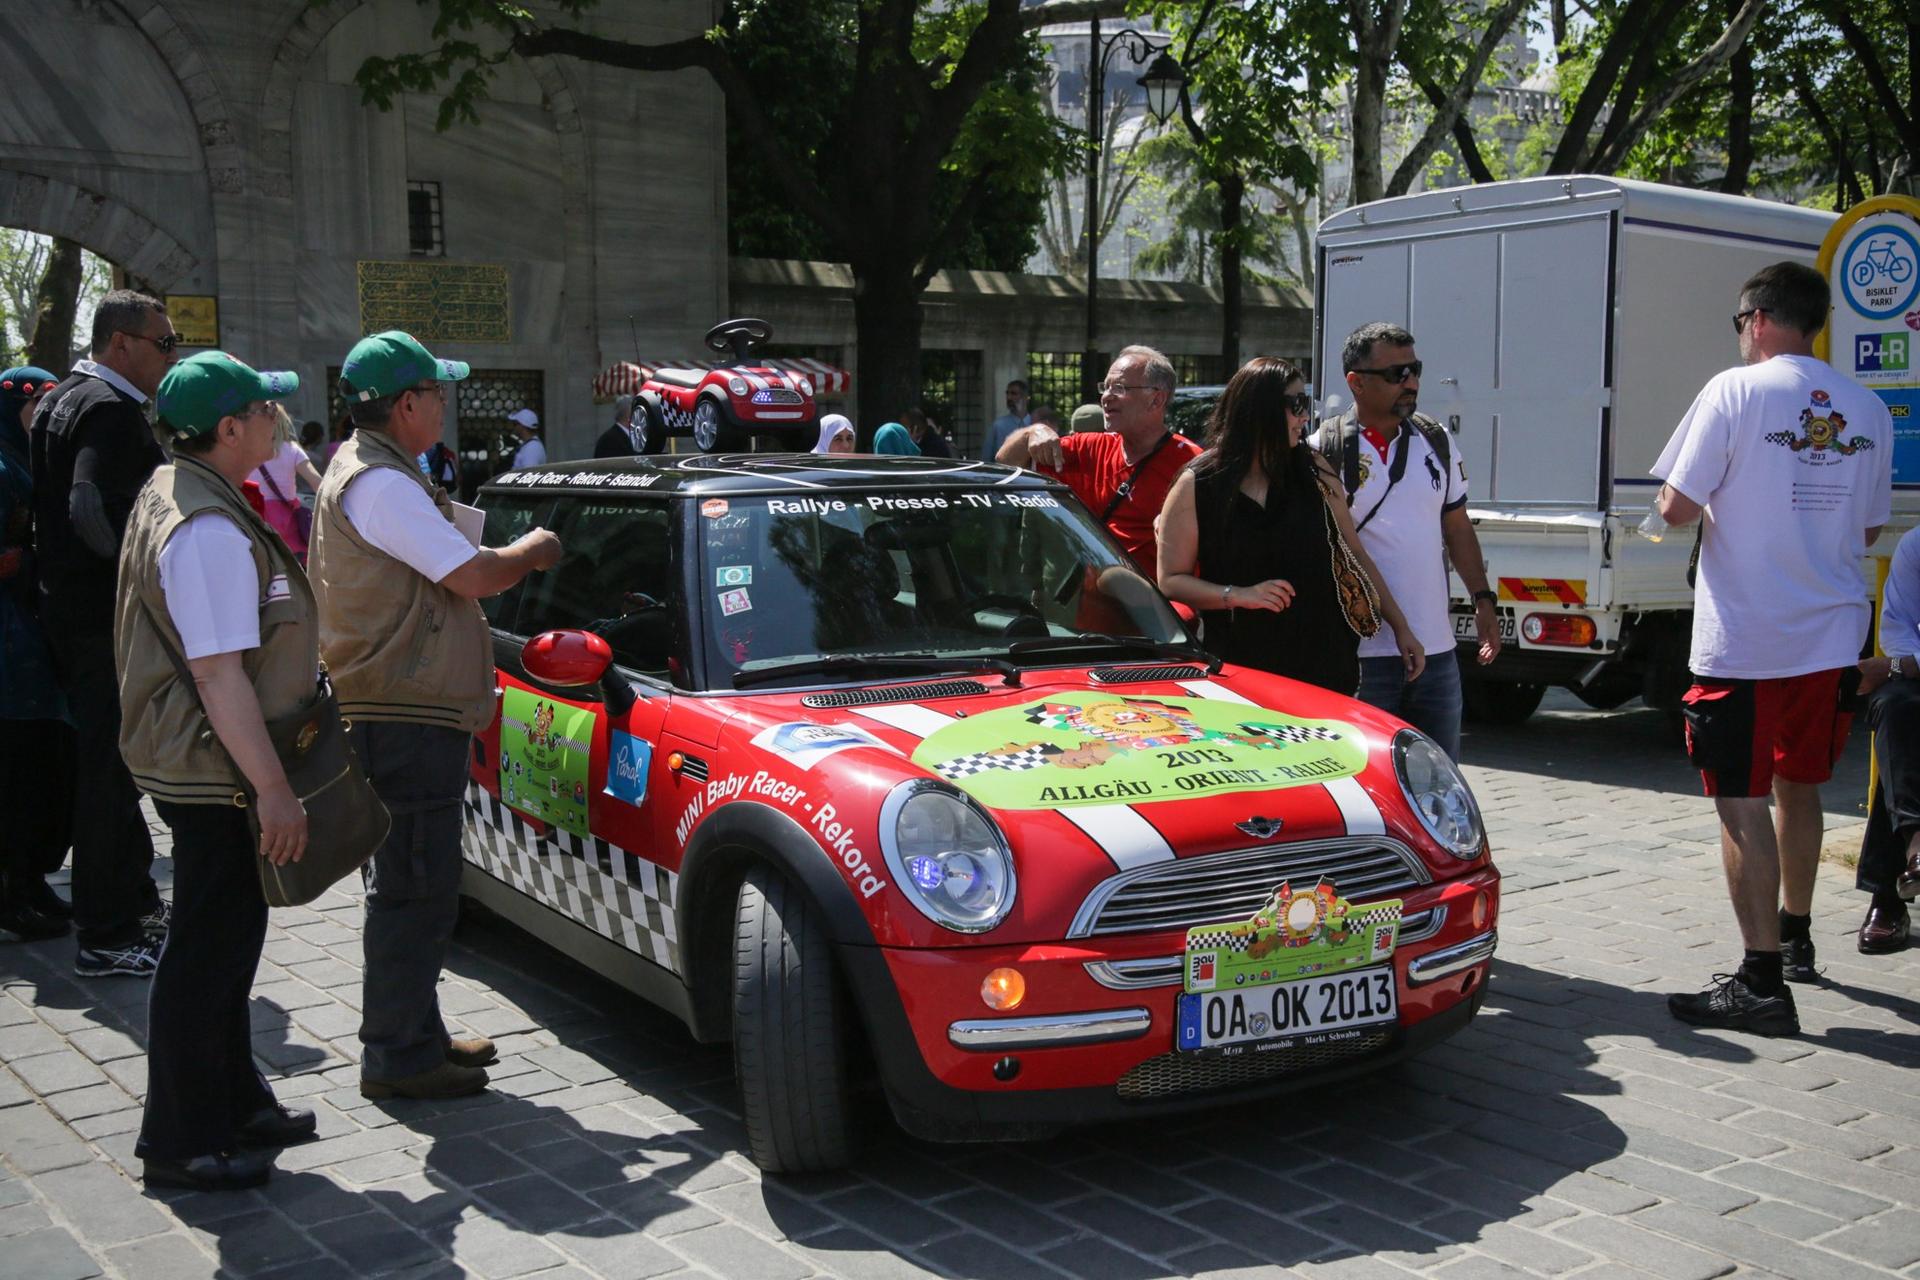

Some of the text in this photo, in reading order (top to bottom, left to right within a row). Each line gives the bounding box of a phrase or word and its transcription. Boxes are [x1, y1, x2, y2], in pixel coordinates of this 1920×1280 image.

[1859, 338, 1905, 366] P+R
[518, 472, 544, 487] Baby
[539, 472, 568, 484] Racer
[569, 472, 611, 485] Rekord
[609, 473, 662, 487] Istanbul
[767, 499, 846, 515] Rallye
[867, 496, 948, 511] Presse
[962, 494, 992, 508] TV
[1005, 494, 1059, 508] Radio
[1455, 616, 1474, 634] EF
[1156, 748, 1234, 769] 2013
[1039, 780, 1152, 801] ALLGÄU
[1174, 768, 1265, 792] ORIENT
[1285, 756, 1347, 779] RALLYE
[675, 791, 703, 847] MINI
[707, 772, 749, 806] Baby
[748, 771, 806, 807] Racer
[811, 802, 887, 899] Rekord
[1206, 973, 1392, 1039] OA OK 2013
[1186, 1027, 1195, 1040] D
[1256, 1038, 1294, 1052] Automobile
[1305, 1034, 1326, 1045] Markt
[1329, 1030, 1361, 1041] Schwaben
